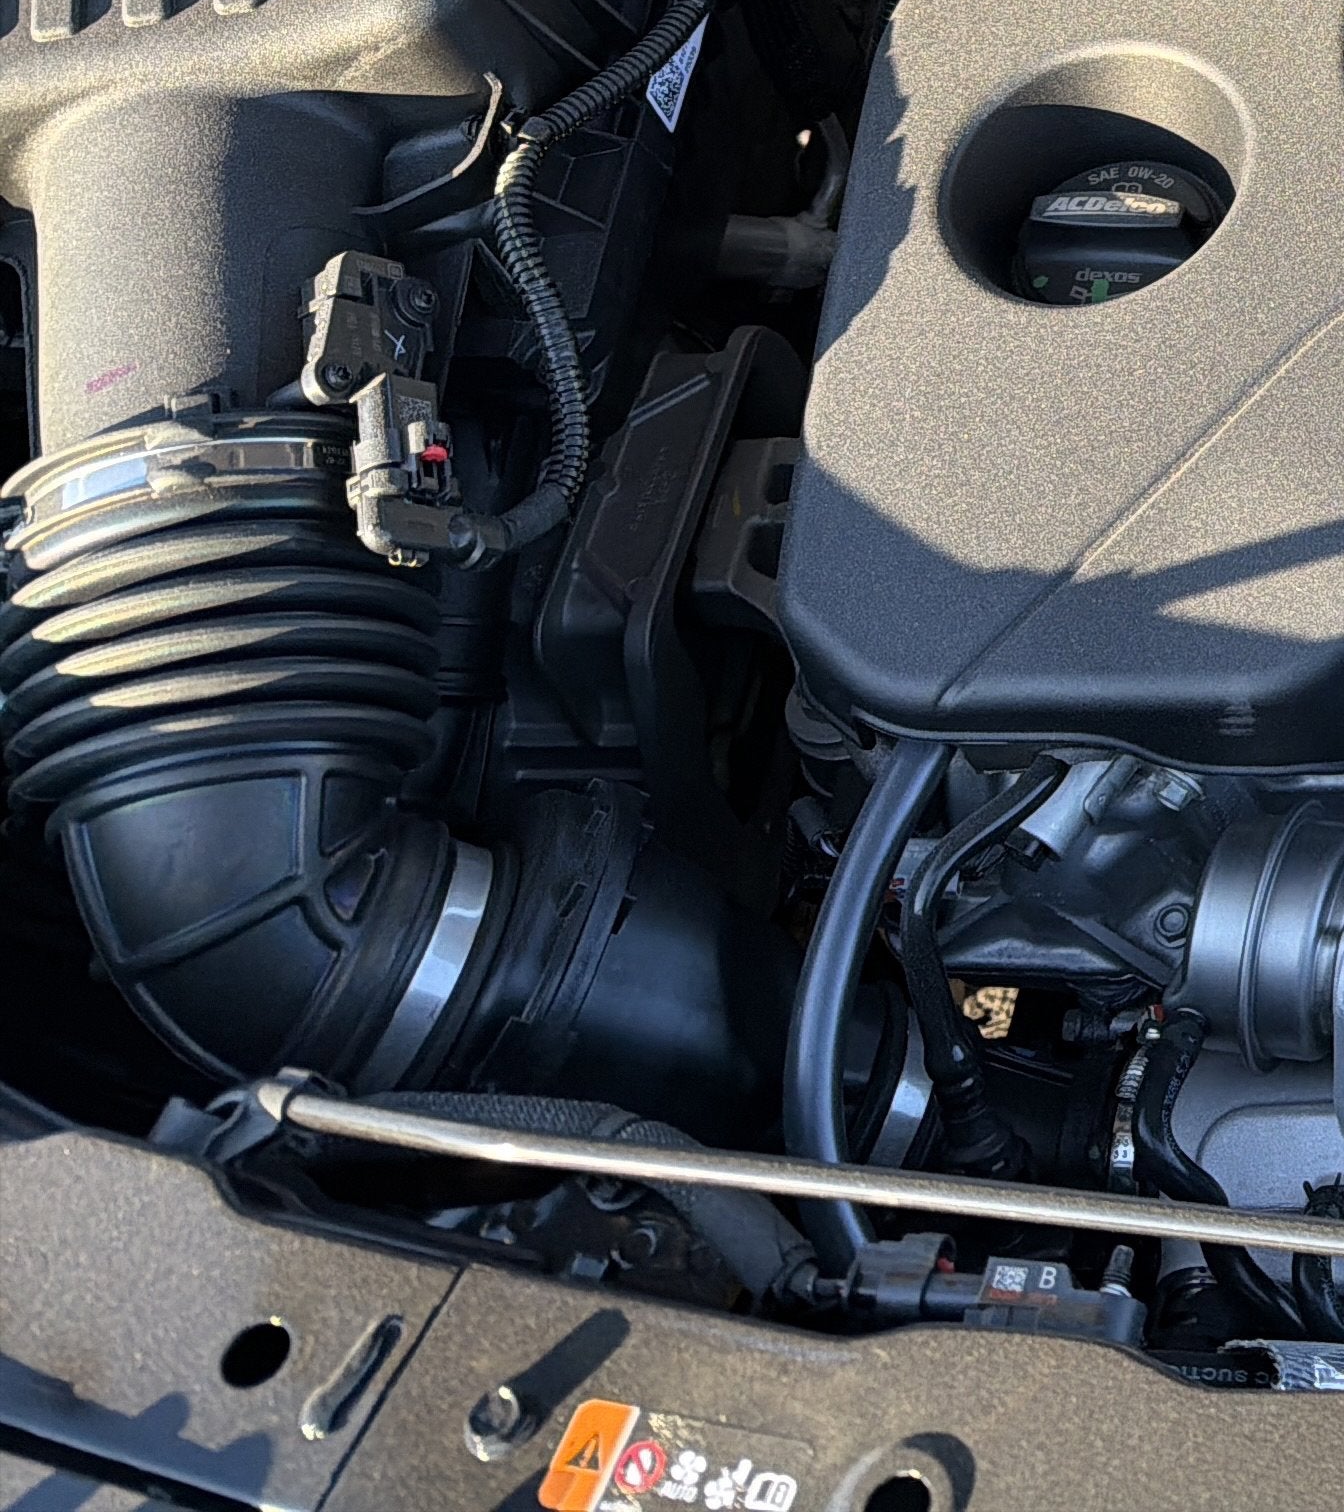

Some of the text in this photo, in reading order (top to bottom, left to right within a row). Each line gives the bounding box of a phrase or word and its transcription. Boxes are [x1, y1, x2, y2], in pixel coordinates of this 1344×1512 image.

[1088, 166, 1174, 189] SAE 0W-20
[1046, 196, 1166, 214] ACDelco
[1074, 267, 1142, 284] dexos
[1038, 1266, 1056, 1289] B
